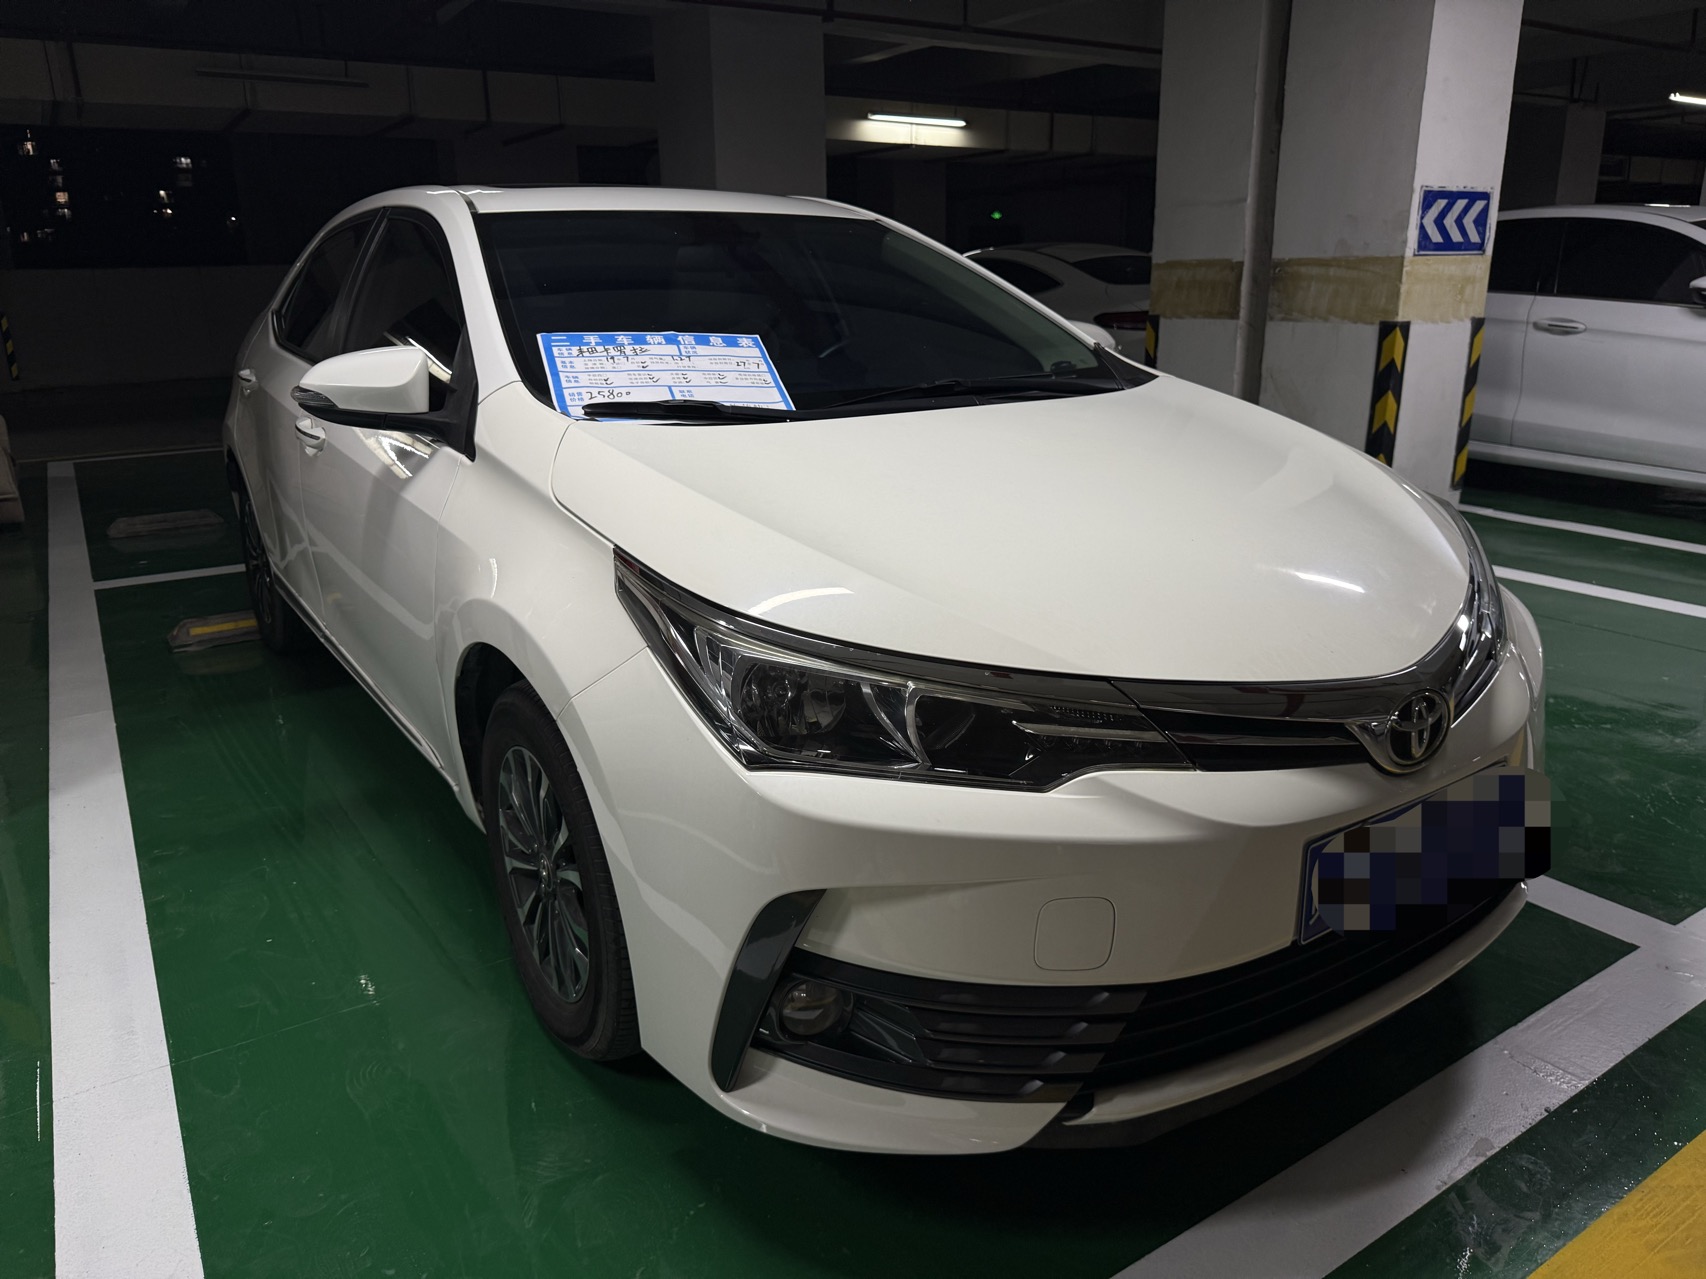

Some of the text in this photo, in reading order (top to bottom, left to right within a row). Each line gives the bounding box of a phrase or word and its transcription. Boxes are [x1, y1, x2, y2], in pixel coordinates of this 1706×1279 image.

[551, 335, 756, 348] 二手车辆信息表
[586, 389, 631, 400] 25800
